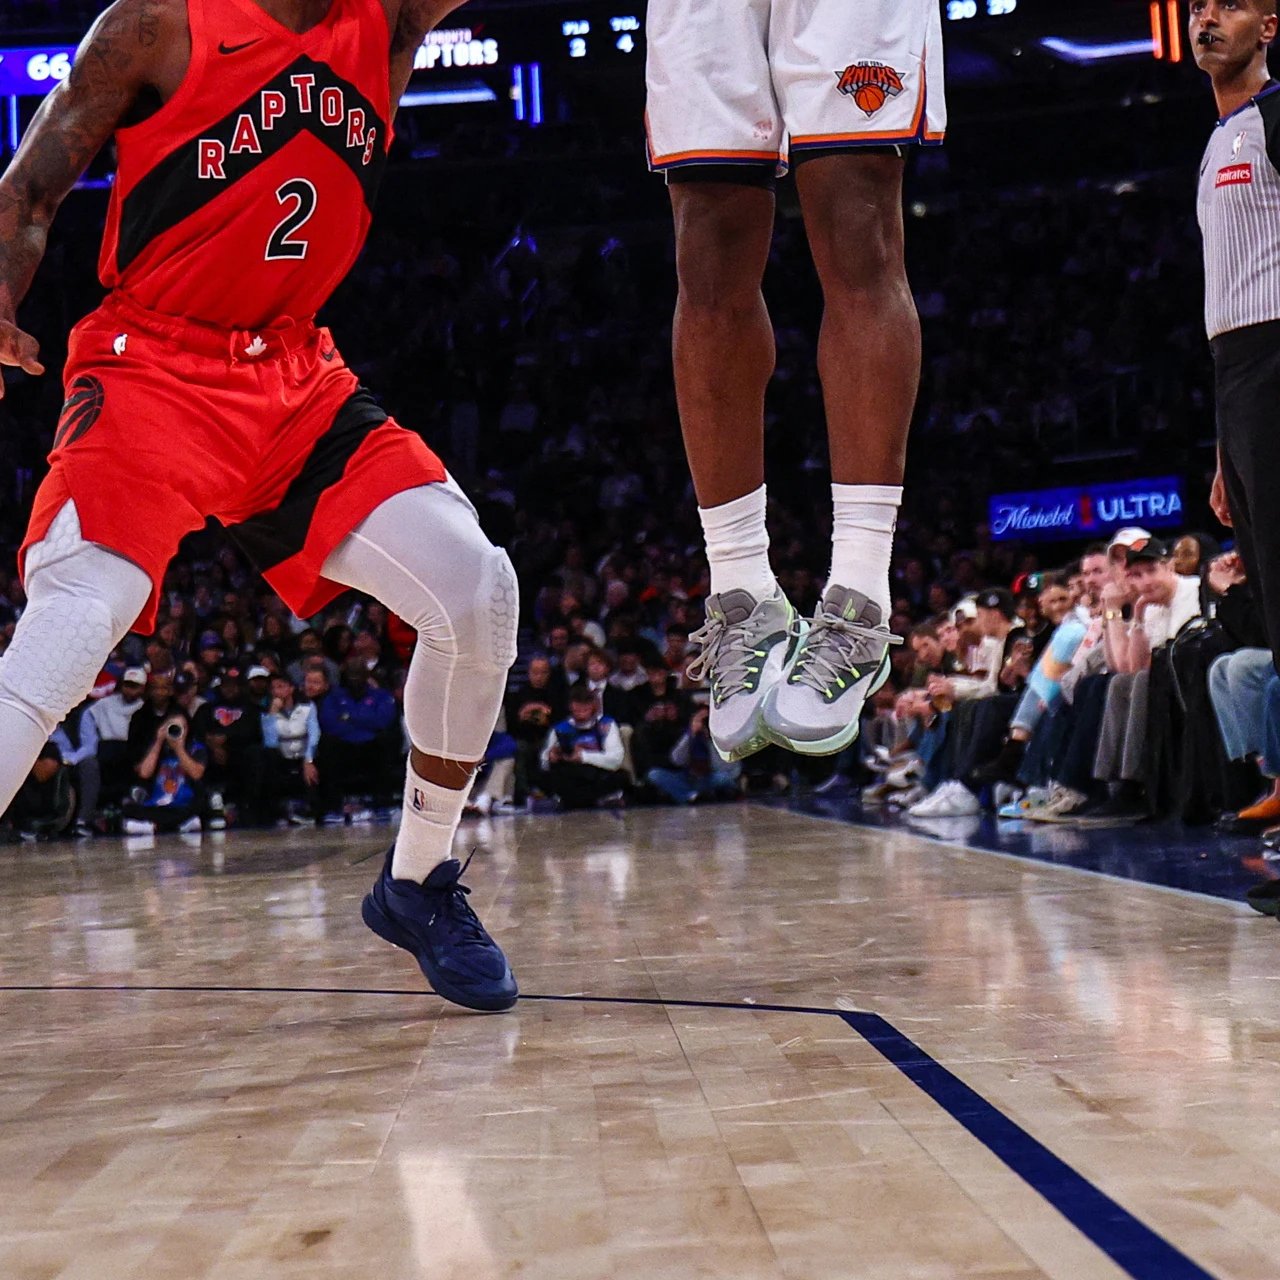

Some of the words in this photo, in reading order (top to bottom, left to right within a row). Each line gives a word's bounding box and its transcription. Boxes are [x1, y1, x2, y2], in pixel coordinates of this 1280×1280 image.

[412, 39, 498, 69] APTORS
[570, 38, 586, 57] 2
[617, 33, 634, 53] 4
[27, 53, 71, 80] 66
[837, 65, 903, 91] KNICKS
[198, 73, 376, 179] RAPTORS
[1216, 169, 1251, 185] Emirates
[264, 177, 317, 261] 2
[1097, 490, 1183, 522] ULTRA
